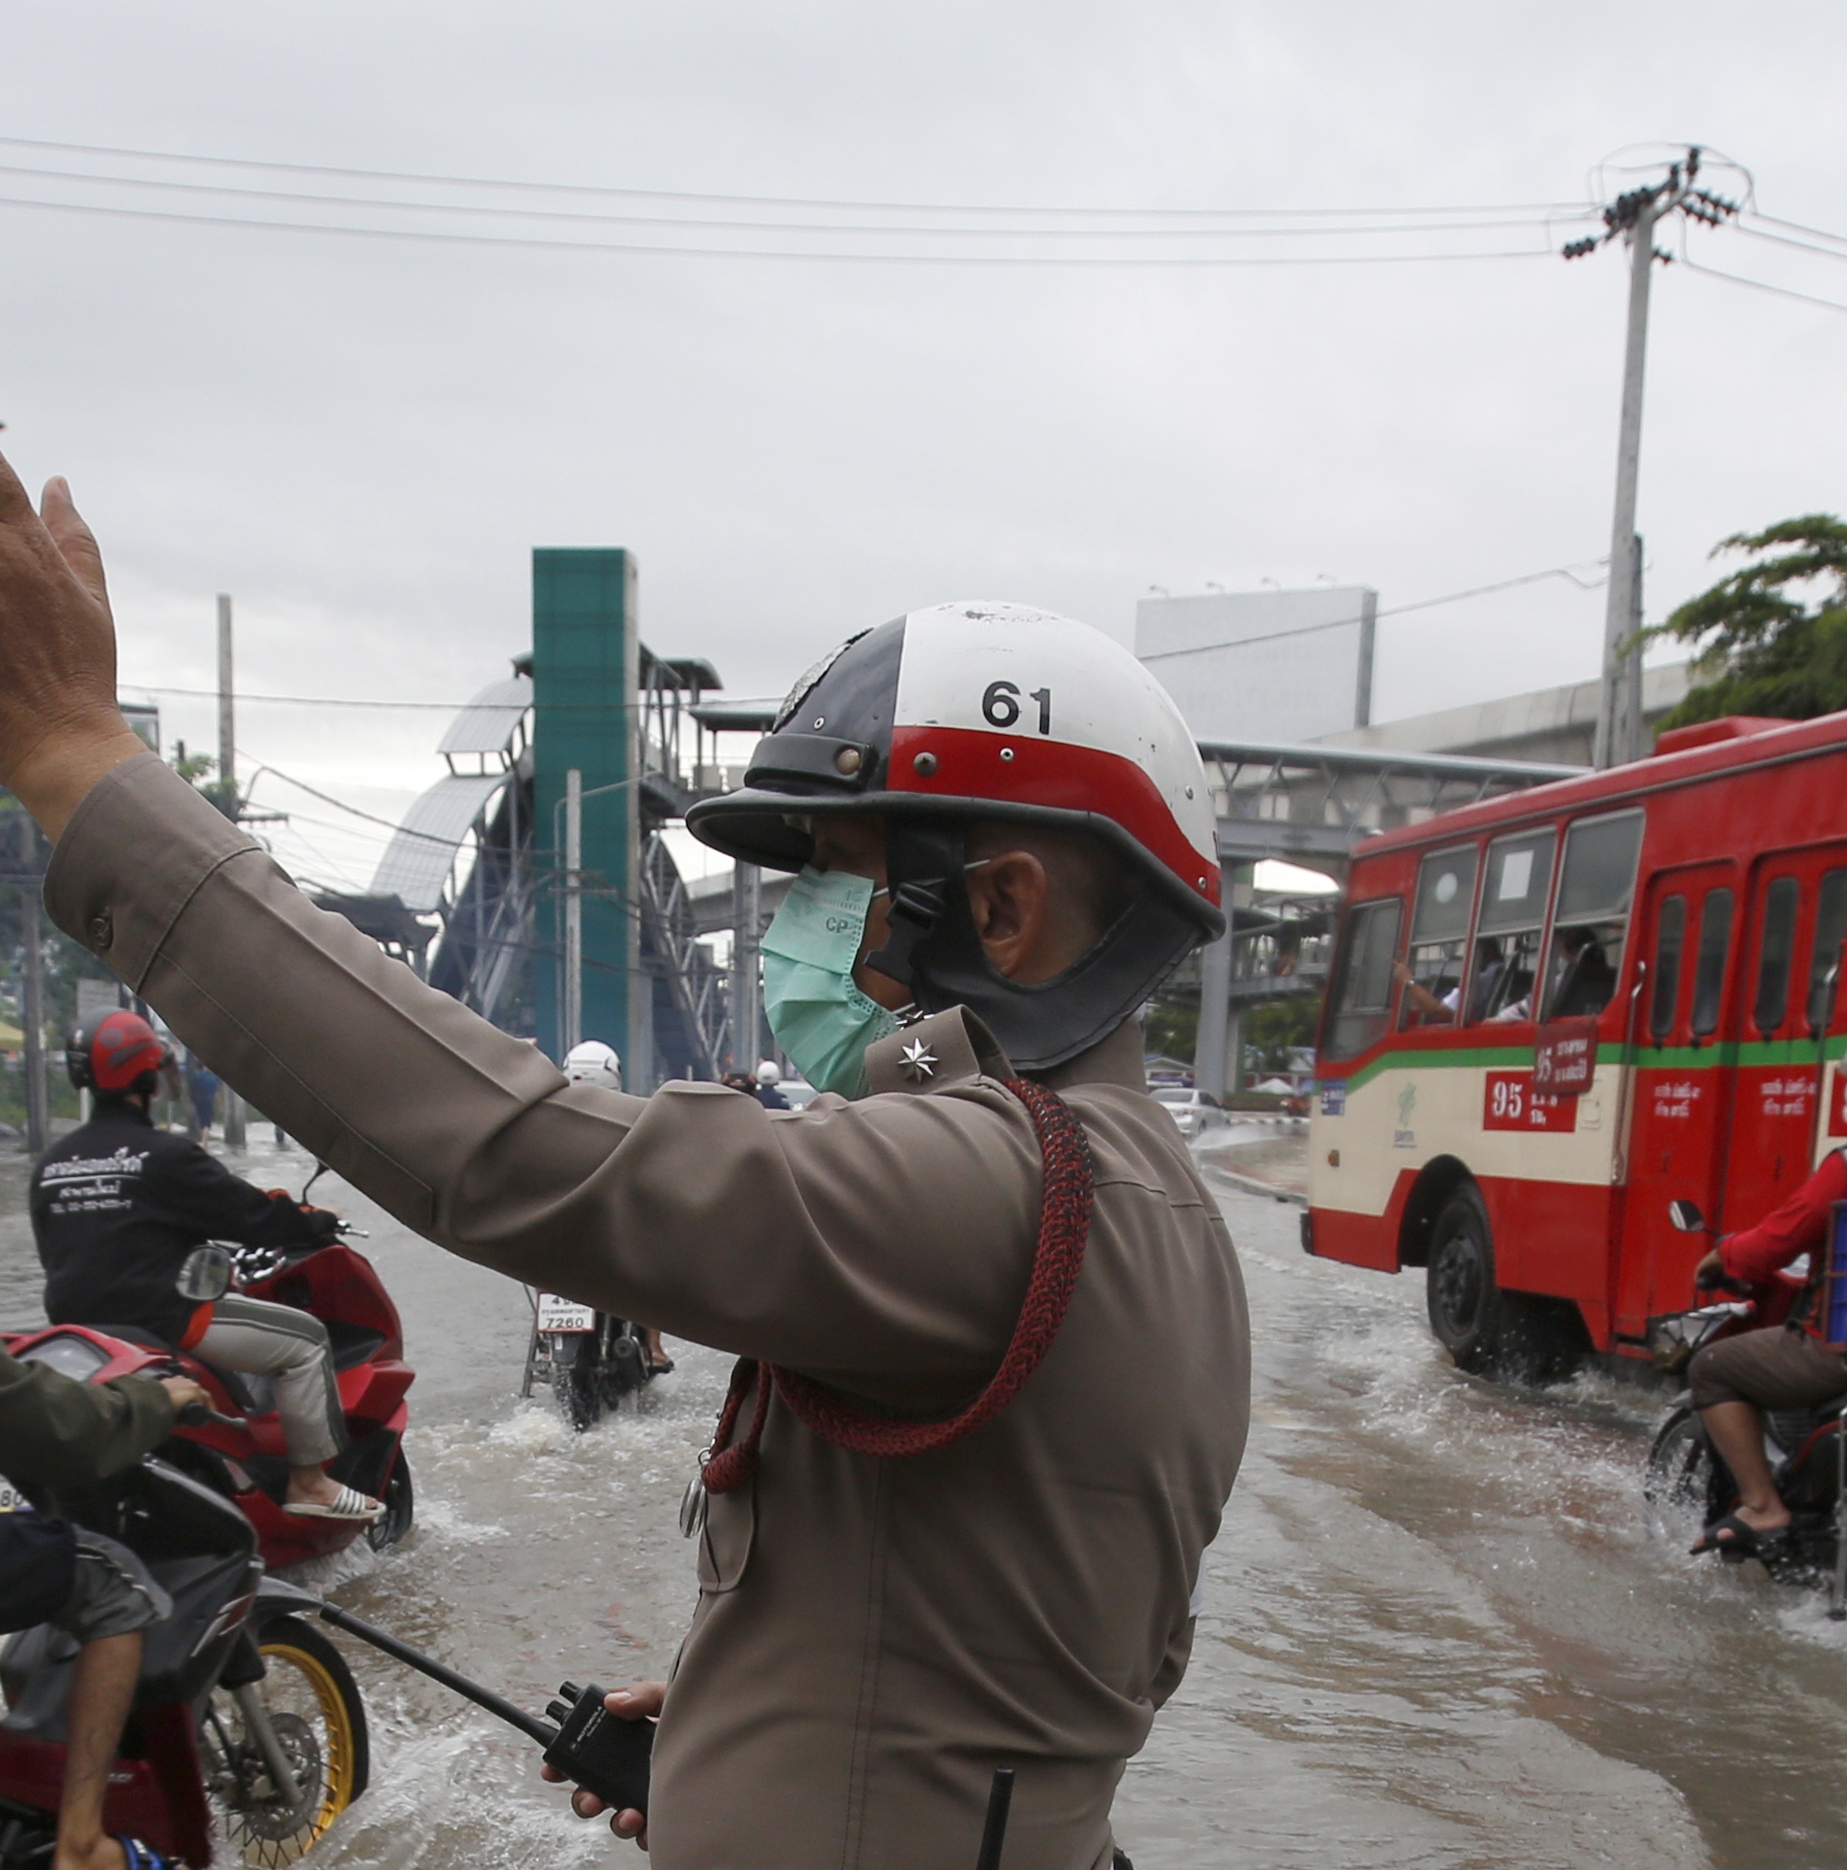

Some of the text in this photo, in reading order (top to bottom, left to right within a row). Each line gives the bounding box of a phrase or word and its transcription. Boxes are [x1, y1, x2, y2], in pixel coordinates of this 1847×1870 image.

[981, 680, 1051, 735] 61
[825, 916, 850, 933] CP
[1491, 1080, 1524, 1118] 95
[546, 1316, 585, 1329] 7260
